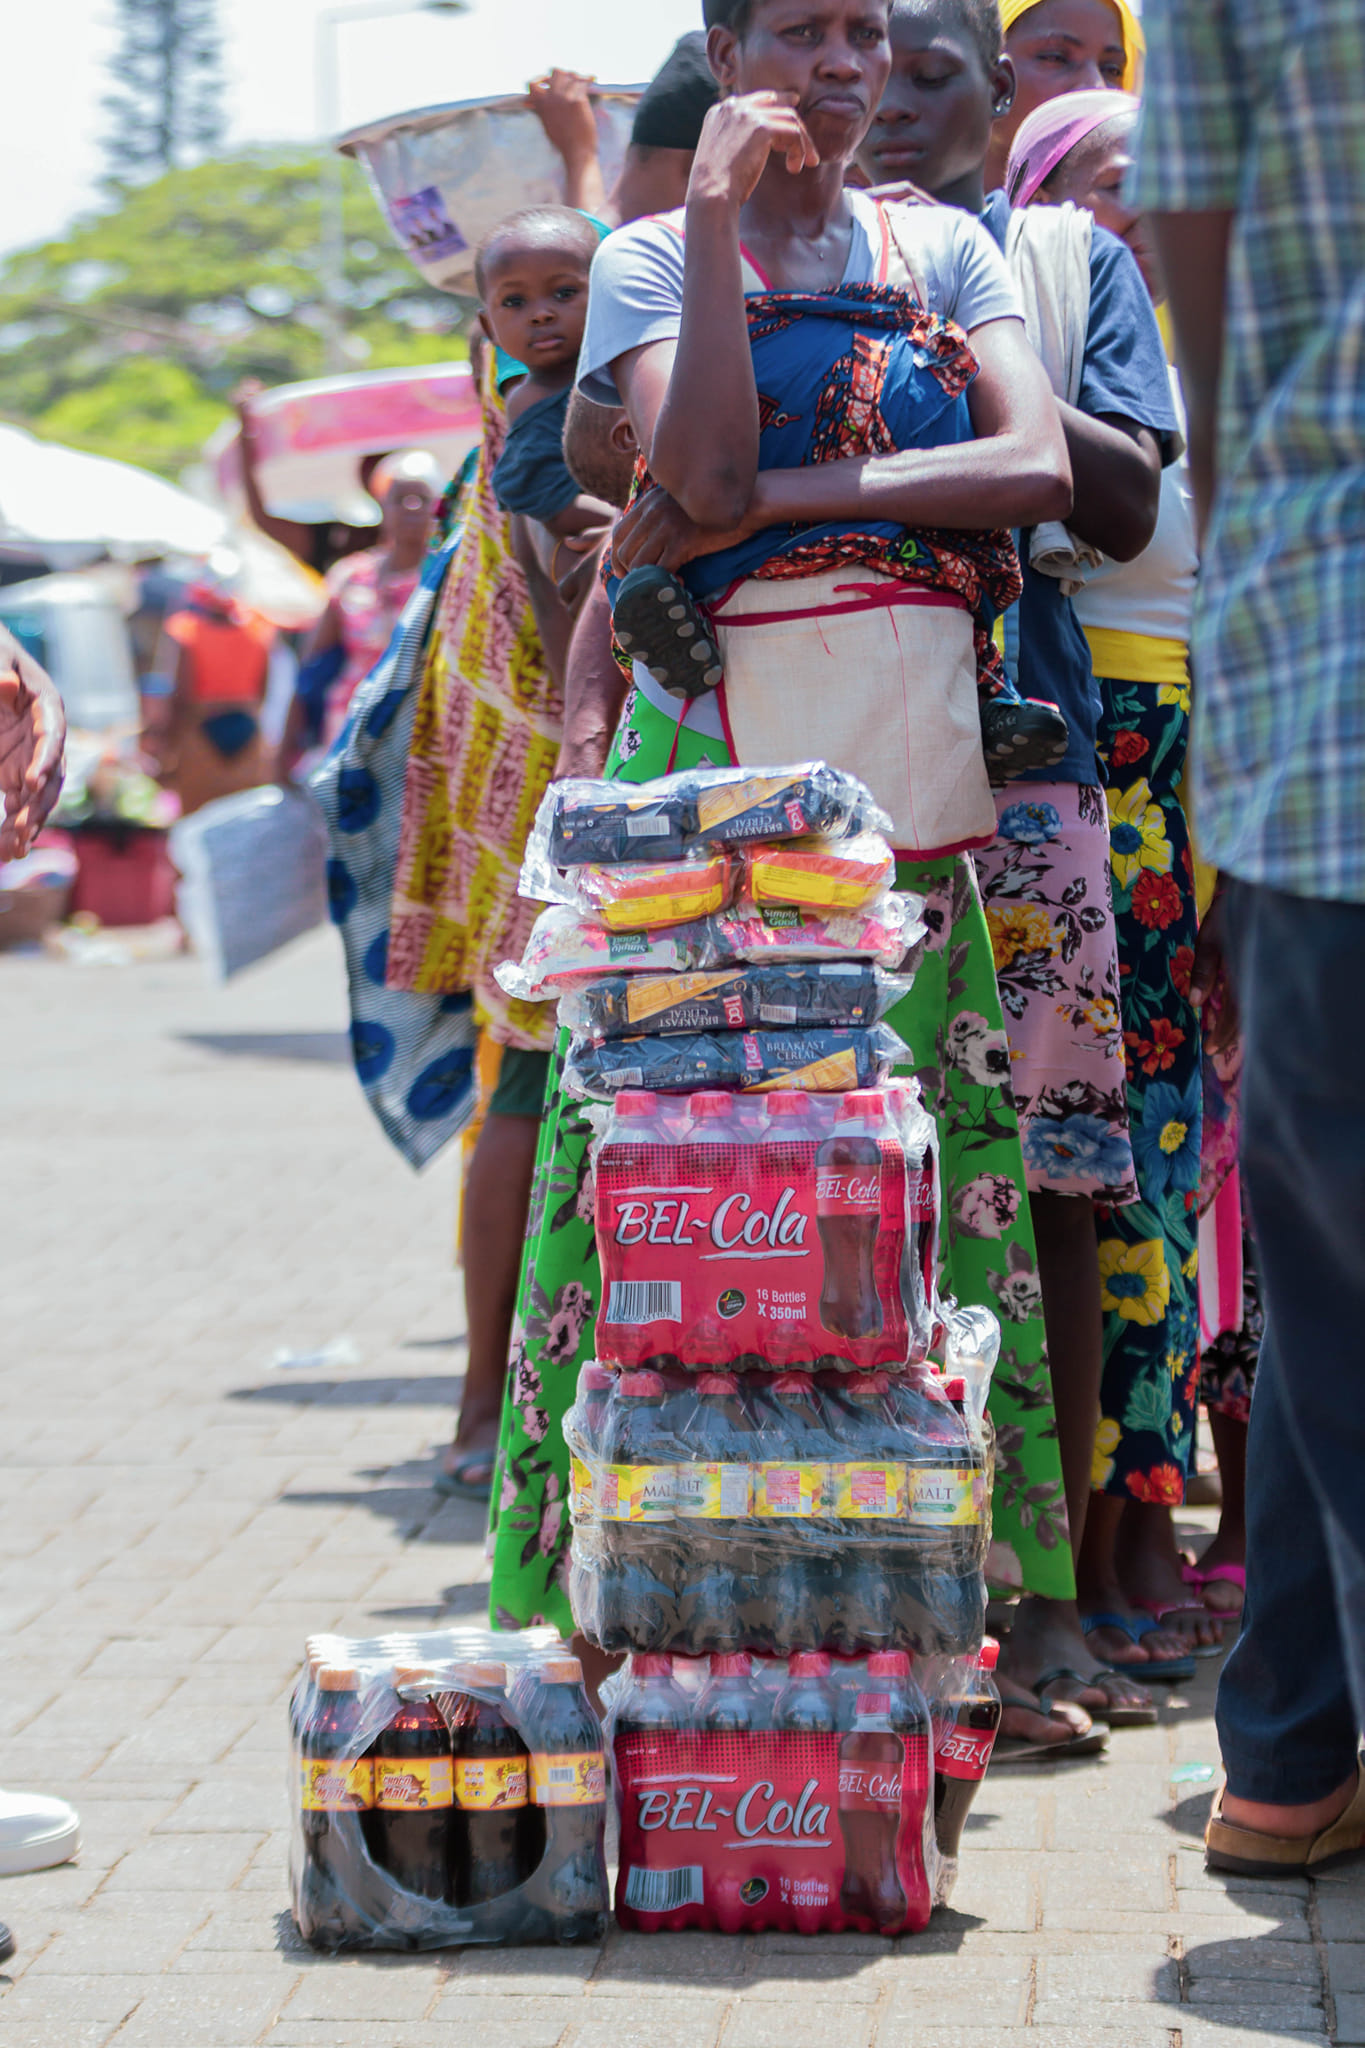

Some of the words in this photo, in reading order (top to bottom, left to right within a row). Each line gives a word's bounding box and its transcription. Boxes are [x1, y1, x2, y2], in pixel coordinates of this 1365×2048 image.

[735, 815, 773, 829] CEREAL
[725, 822, 784, 838] BREAKFAST
[763, 908, 798, 919] Simply
[769, 917, 798, 927] Good
[670, 1007, 709, 1018] CEREAL
[658, 1015, 719, 1028] BREAKFAST
[766, 1040, 825, 1052] BREAKFAST
[776, 1049, 818, 1061] CEREAL
[815, 1175, 880, 1200] BEL-Cola
[615, 1187, 808, 1249] BEL-Cola
[756, 1288, 769, 1301] 16
[771, 1290, 806, 1304] Bottles
[769, 1305, 807, 1320] 350ml
[912, 1487, 954, 1501] MALT
[383, 1774, 413, 1786] CHOCO
[838, 1773, 902, 1798] BEL-Cola
[637, 1778, 831, 1838] BEL-Cola
[779, 1876, 791, 1891] 16
[793, 1880, 829, 1893] Bottles
[792, 1894, 829, 1906] 350ml
